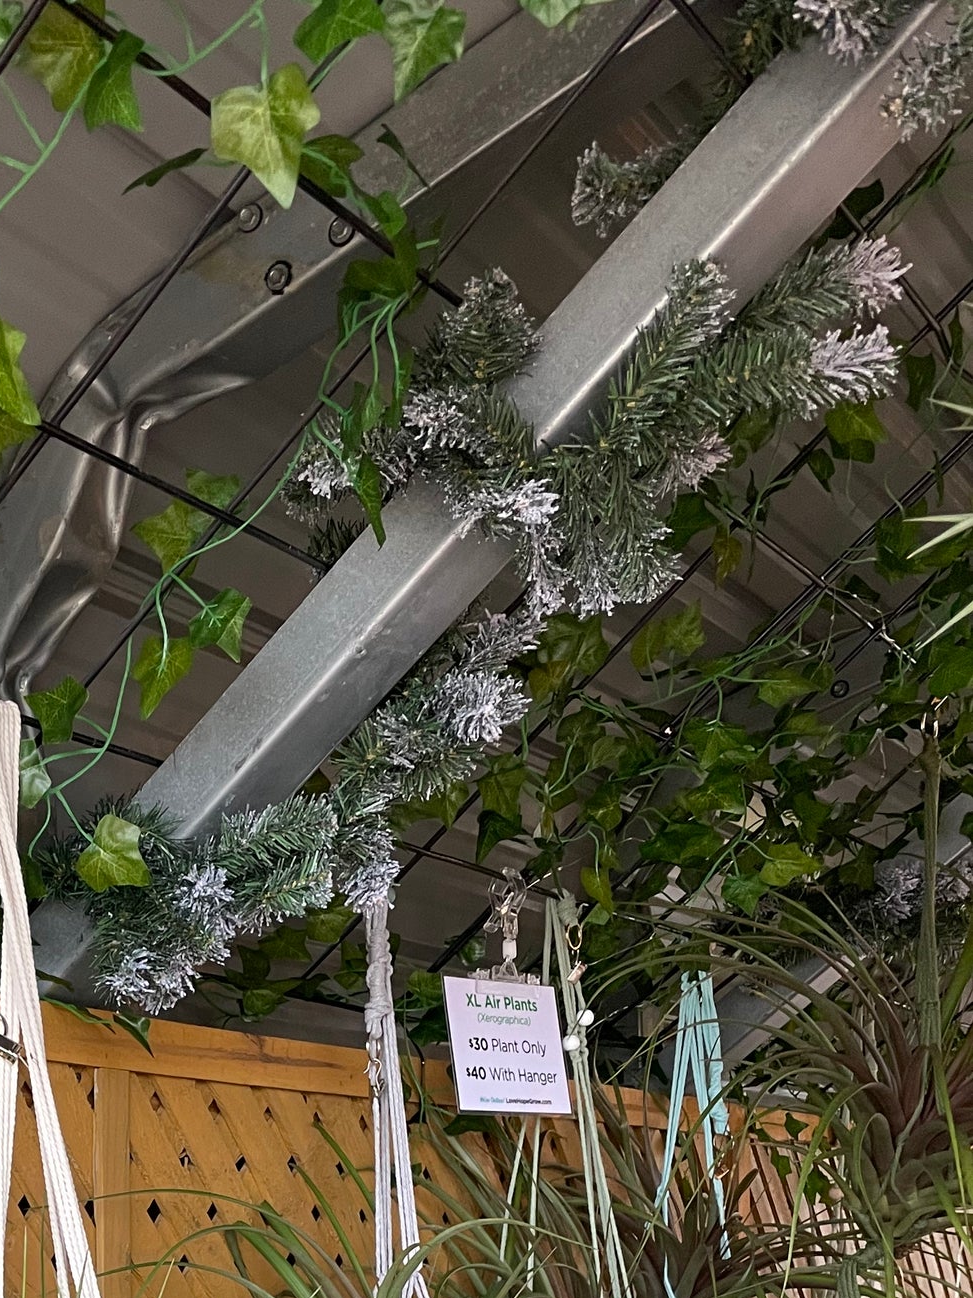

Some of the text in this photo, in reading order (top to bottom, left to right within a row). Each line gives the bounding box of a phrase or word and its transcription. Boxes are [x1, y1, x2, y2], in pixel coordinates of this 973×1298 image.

[465, 993, 538, 1012] XL Air Plants
[477, 1012, 531, 1027] (Xerographica)
[468, 1037, 546, 1058] $30 Plant Only
[466, 1066, 557, 1085] $40 With Hanger
